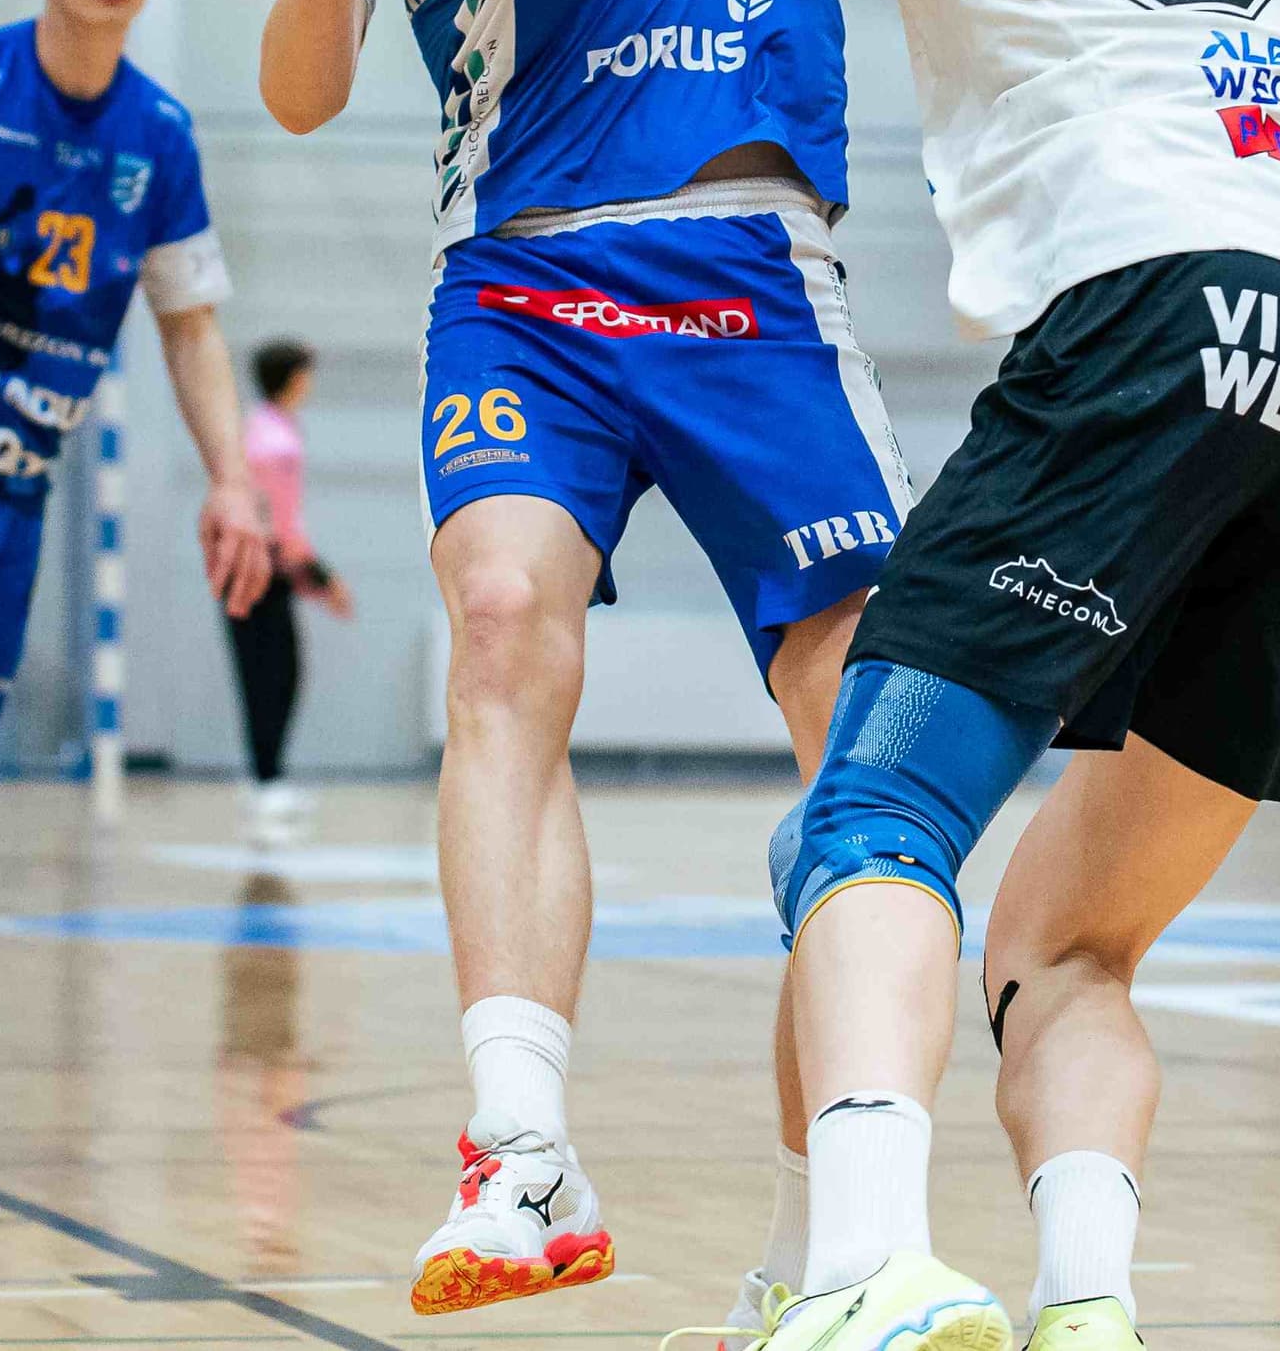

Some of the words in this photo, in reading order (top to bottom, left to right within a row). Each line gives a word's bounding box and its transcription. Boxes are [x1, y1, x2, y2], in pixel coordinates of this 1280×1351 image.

[28, 210, 96, 294] 23
[432, 387, 527, 460] 26
[783, 510, 896, 570] TRB
[1000, 574, 1111, 632] TAHECOM
